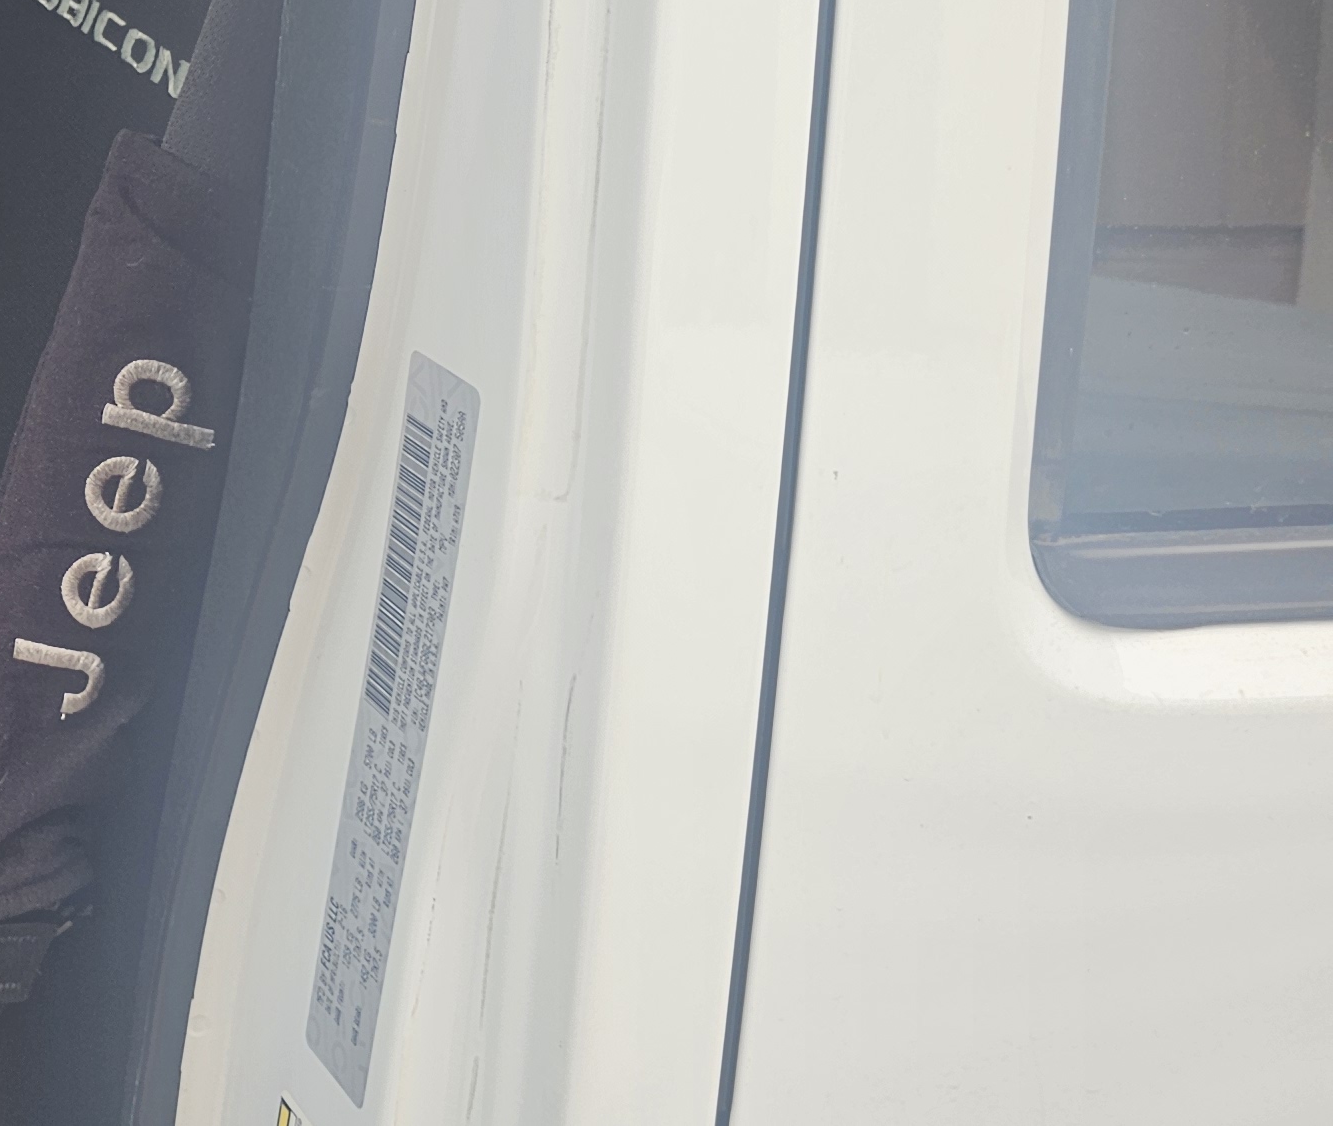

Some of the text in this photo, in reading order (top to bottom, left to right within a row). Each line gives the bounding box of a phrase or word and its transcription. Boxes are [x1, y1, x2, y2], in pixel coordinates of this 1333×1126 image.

[13, 359, 215, 719] Jeep
[320, 939, 332, 972] FCA
[327, 894, 339, 924] LLC
